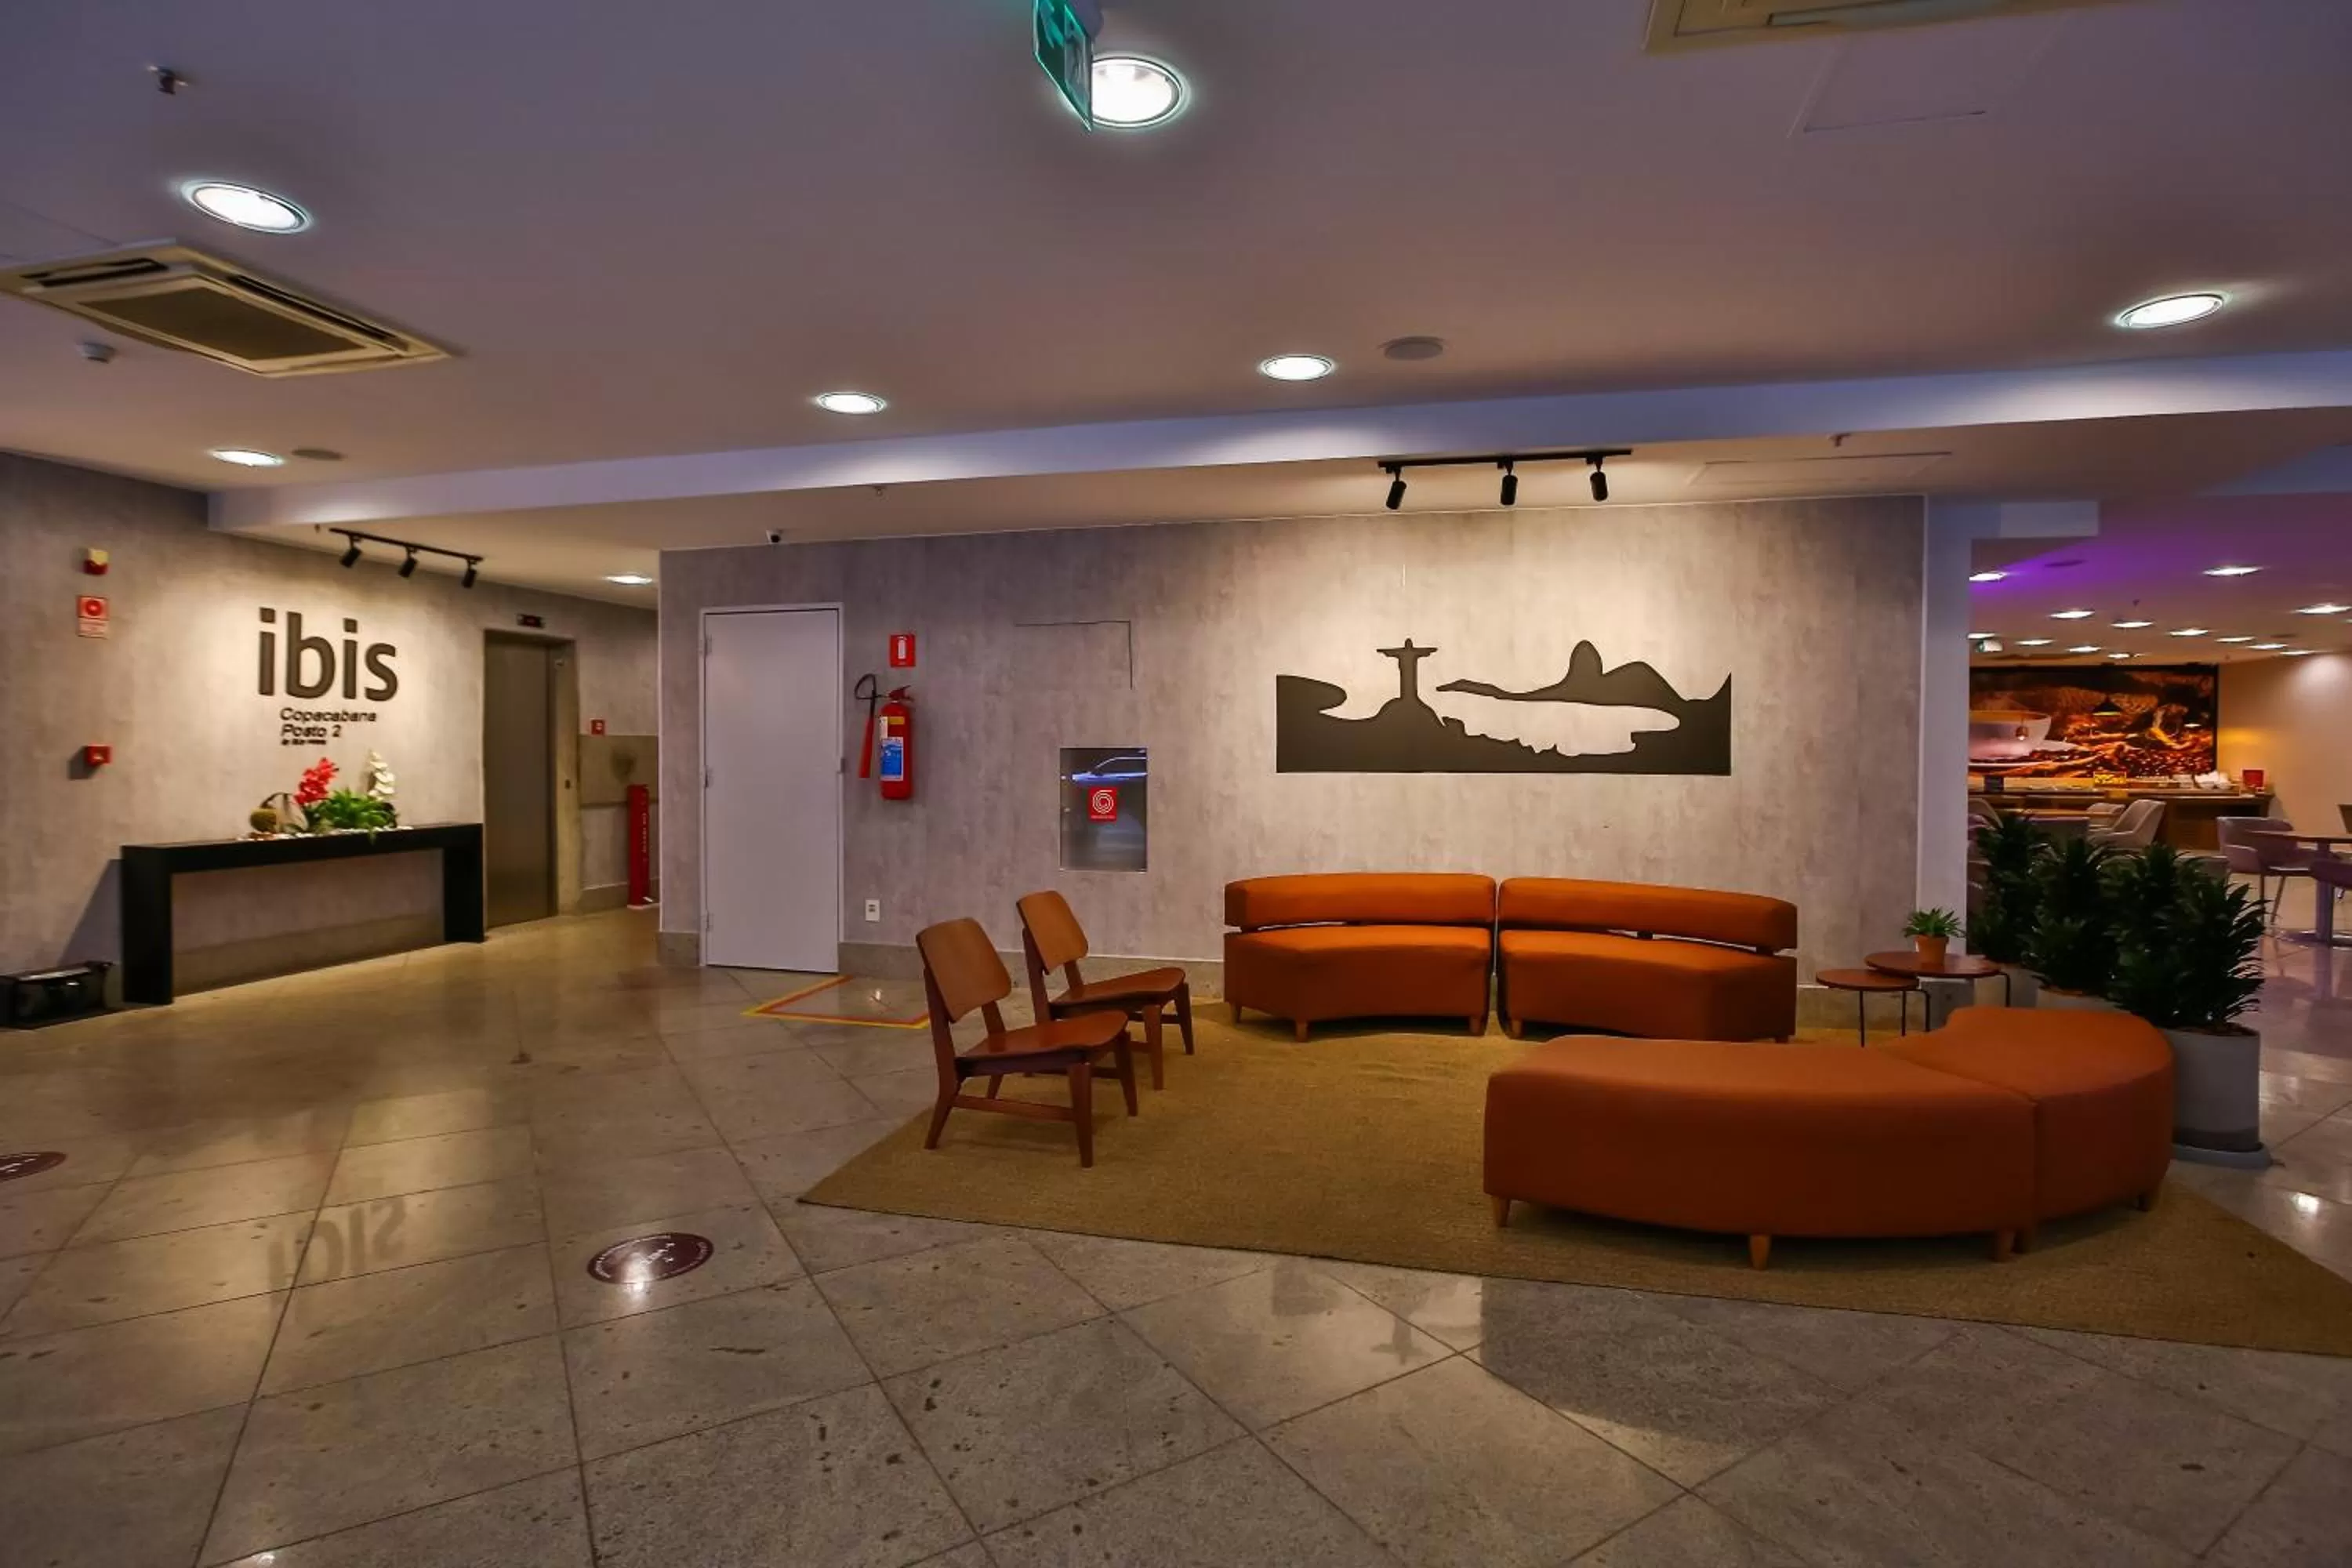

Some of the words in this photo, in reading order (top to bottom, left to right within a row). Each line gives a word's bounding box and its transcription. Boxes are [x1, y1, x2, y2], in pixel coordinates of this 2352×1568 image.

[259, 607, 398, 702] ibis
[280, 707, 377, 724] Copacabana
[281, 724, 327, 737] Posto
[332, 724, 342, 738] 2
